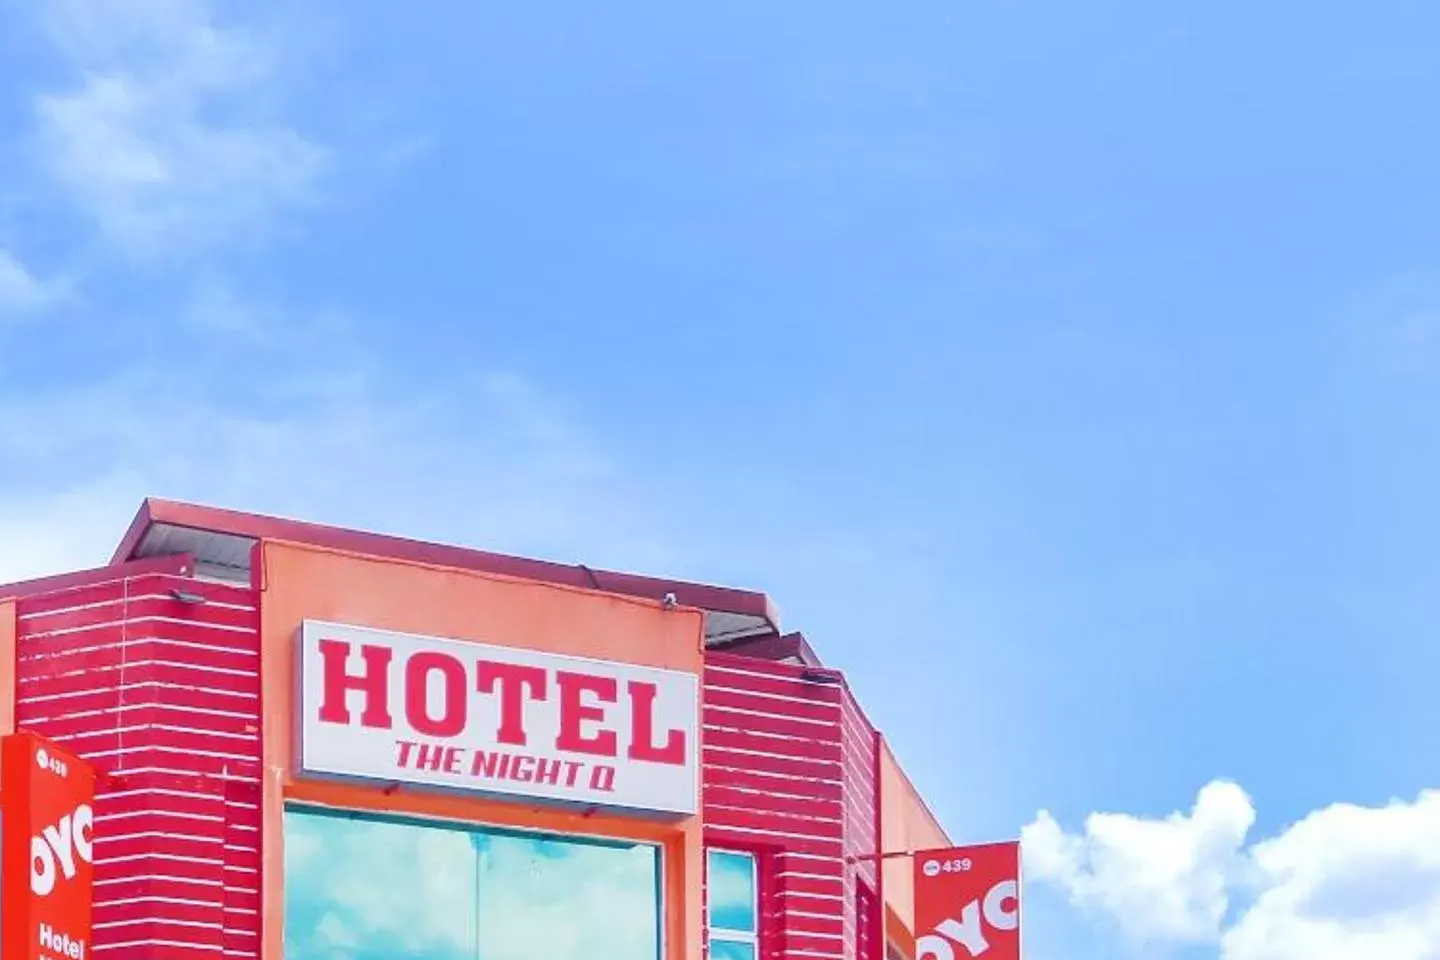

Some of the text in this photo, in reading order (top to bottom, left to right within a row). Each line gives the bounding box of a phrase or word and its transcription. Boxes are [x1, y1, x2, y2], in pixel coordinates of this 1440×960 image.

[318, 639, 686, 765] HOTEL
[396, 740, 615, 792] THE NIGHT Q
[942, 858, 972, 872] 439
